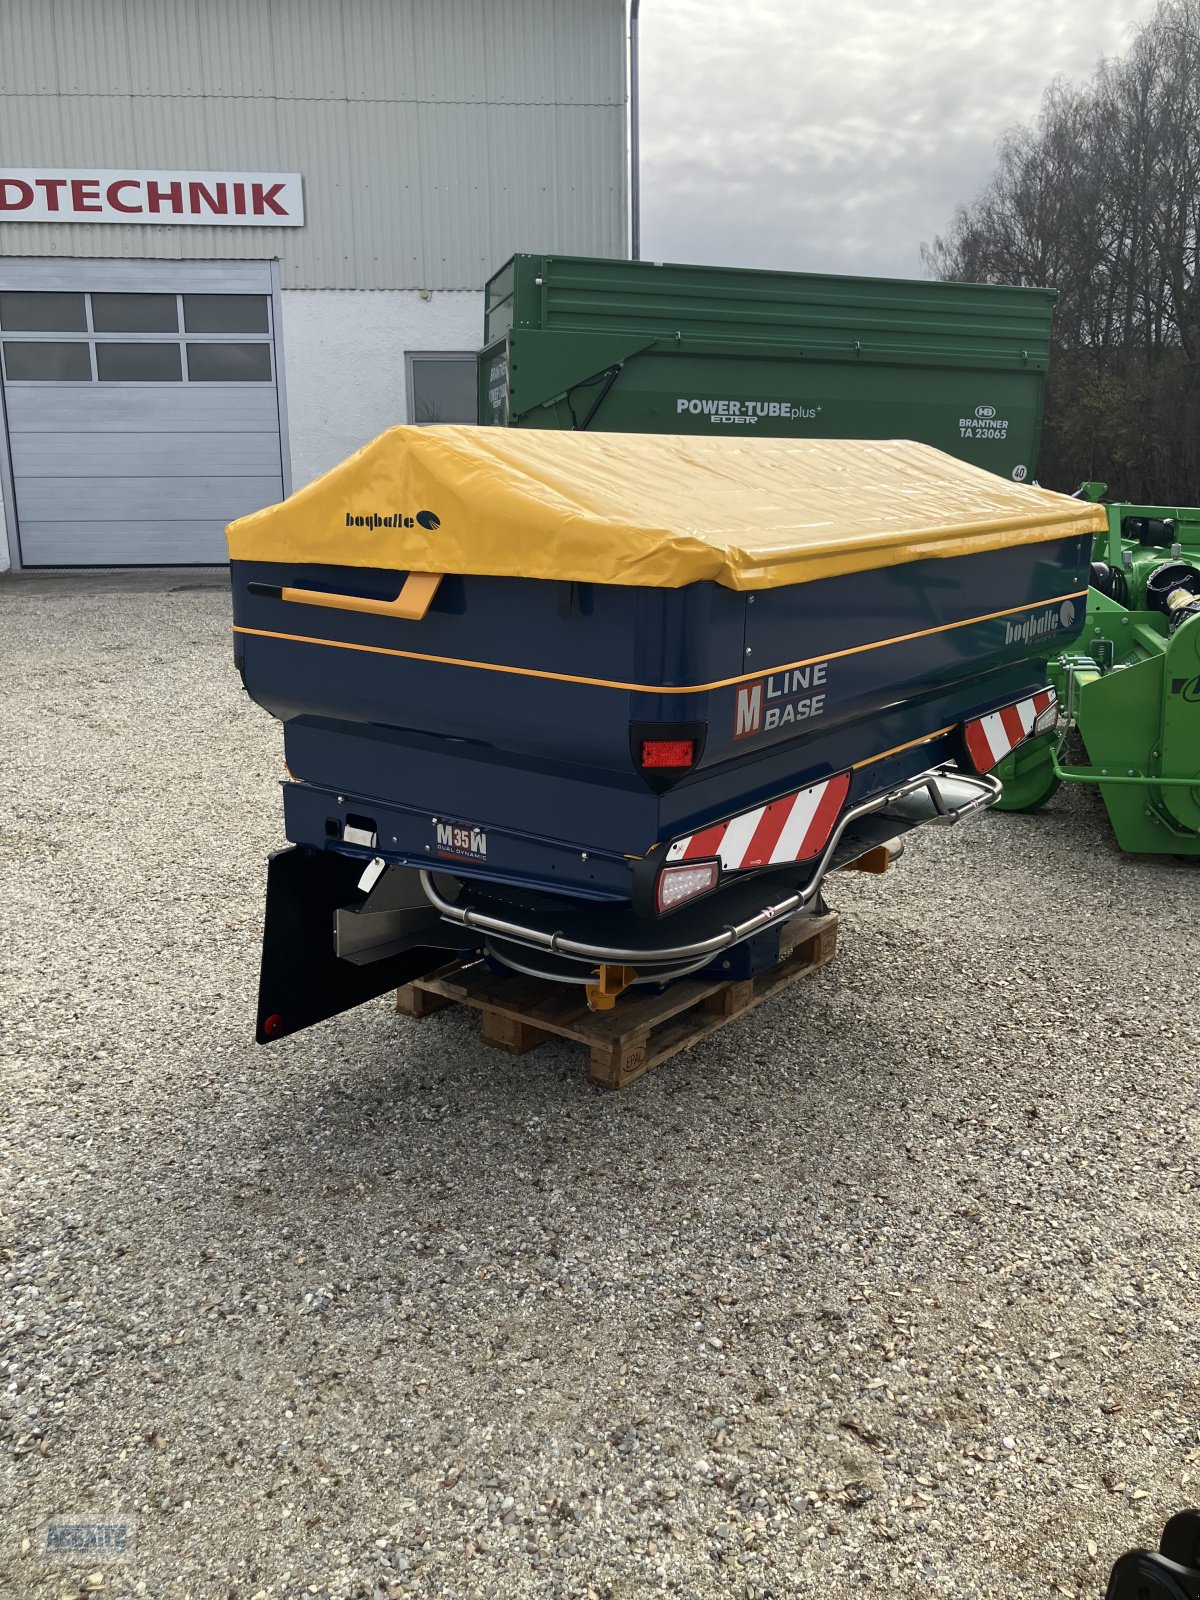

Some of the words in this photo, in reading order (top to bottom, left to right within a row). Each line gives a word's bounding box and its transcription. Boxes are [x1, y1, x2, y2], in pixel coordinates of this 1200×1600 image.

[0, 178, 290, 216] DTECHNIK
[710, 415, 758, 424] EDER
[959, 418, 1009, 429] BRANTNER
[960, 428, 973, 438] TA
[975, 428, 1007, 439] 23065
[1014, 467, 1025, 478] 40
[736, 684, 762, 736] M
[767, 662, 828, 699] LINE
[764, 694, 826, 731] BASE
[437, 844, 455, 853] DUAL
[456, 849, 487, 861] DYNAMIC
